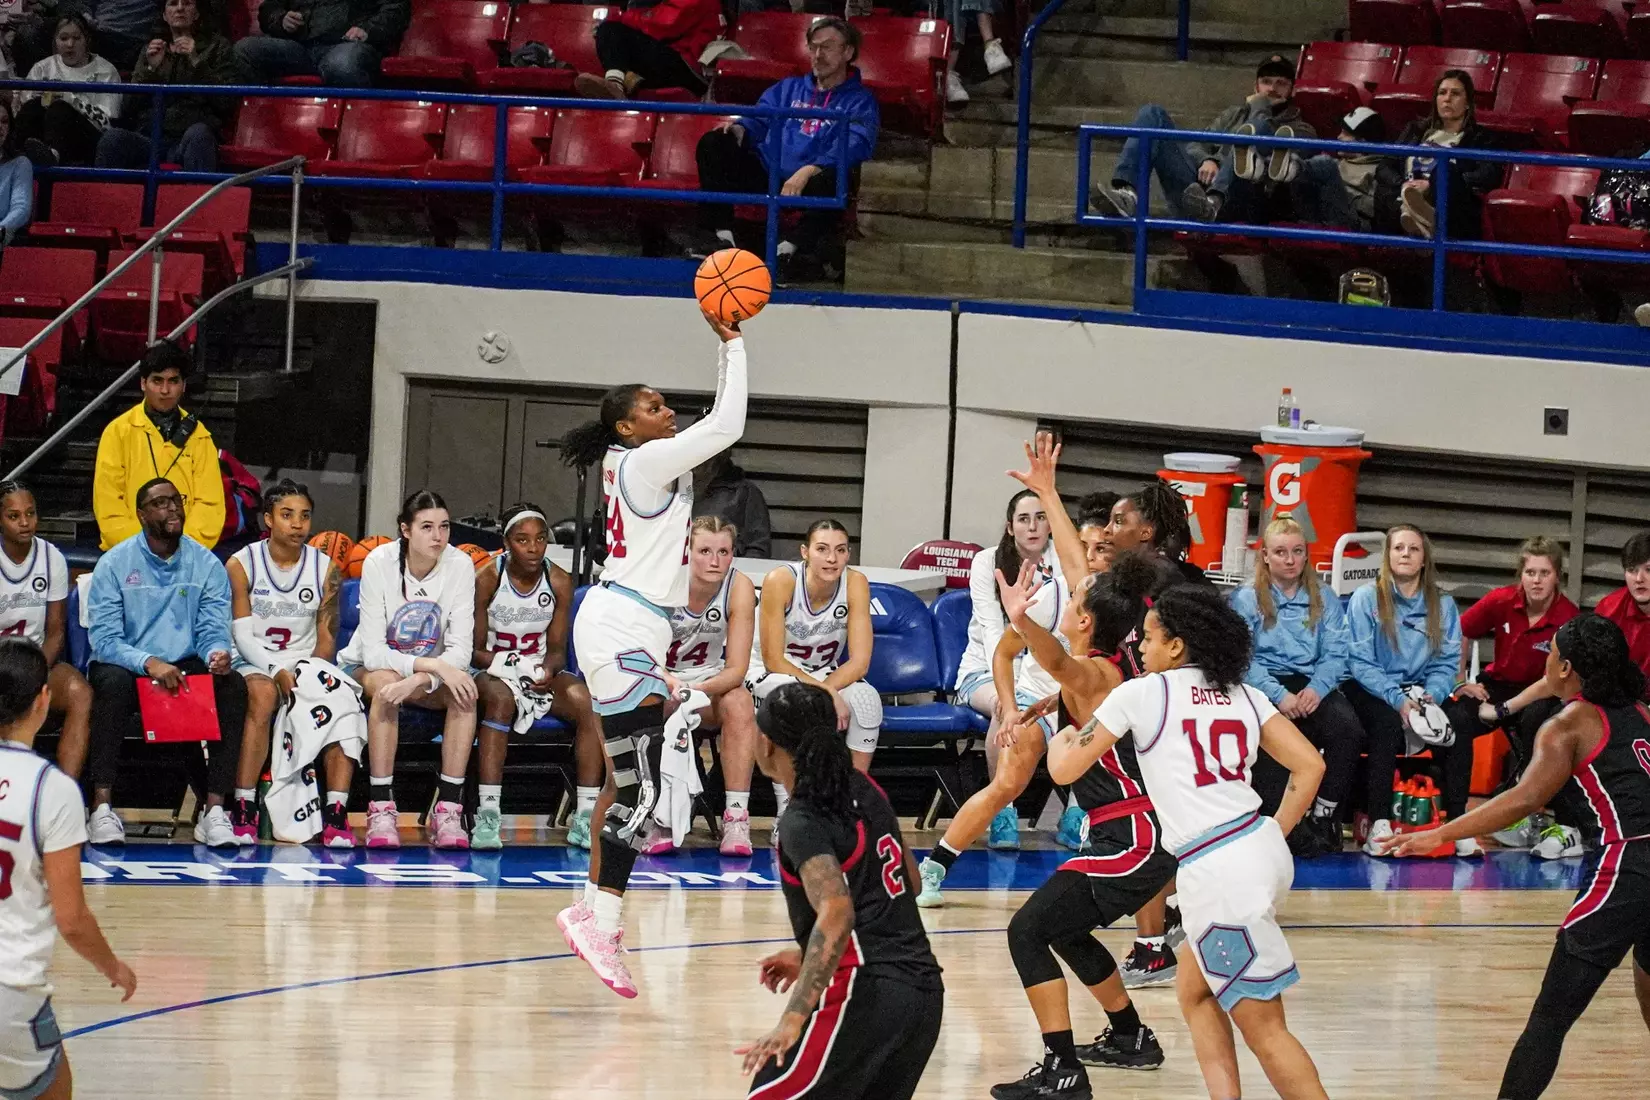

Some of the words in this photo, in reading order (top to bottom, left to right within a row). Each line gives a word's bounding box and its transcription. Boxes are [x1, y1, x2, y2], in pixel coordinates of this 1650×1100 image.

[1269, 463, 1301, 505] G
[923, 546, 975, 559] LOUISIANA
[936, 556, 959, 567] TECH
[1191, 686, 1232, 705] BATES
[1182, 719, 1249, 788] 10
[81, 861, 780, 884] RTS.COM
[876, 833, 906, 899] 2
